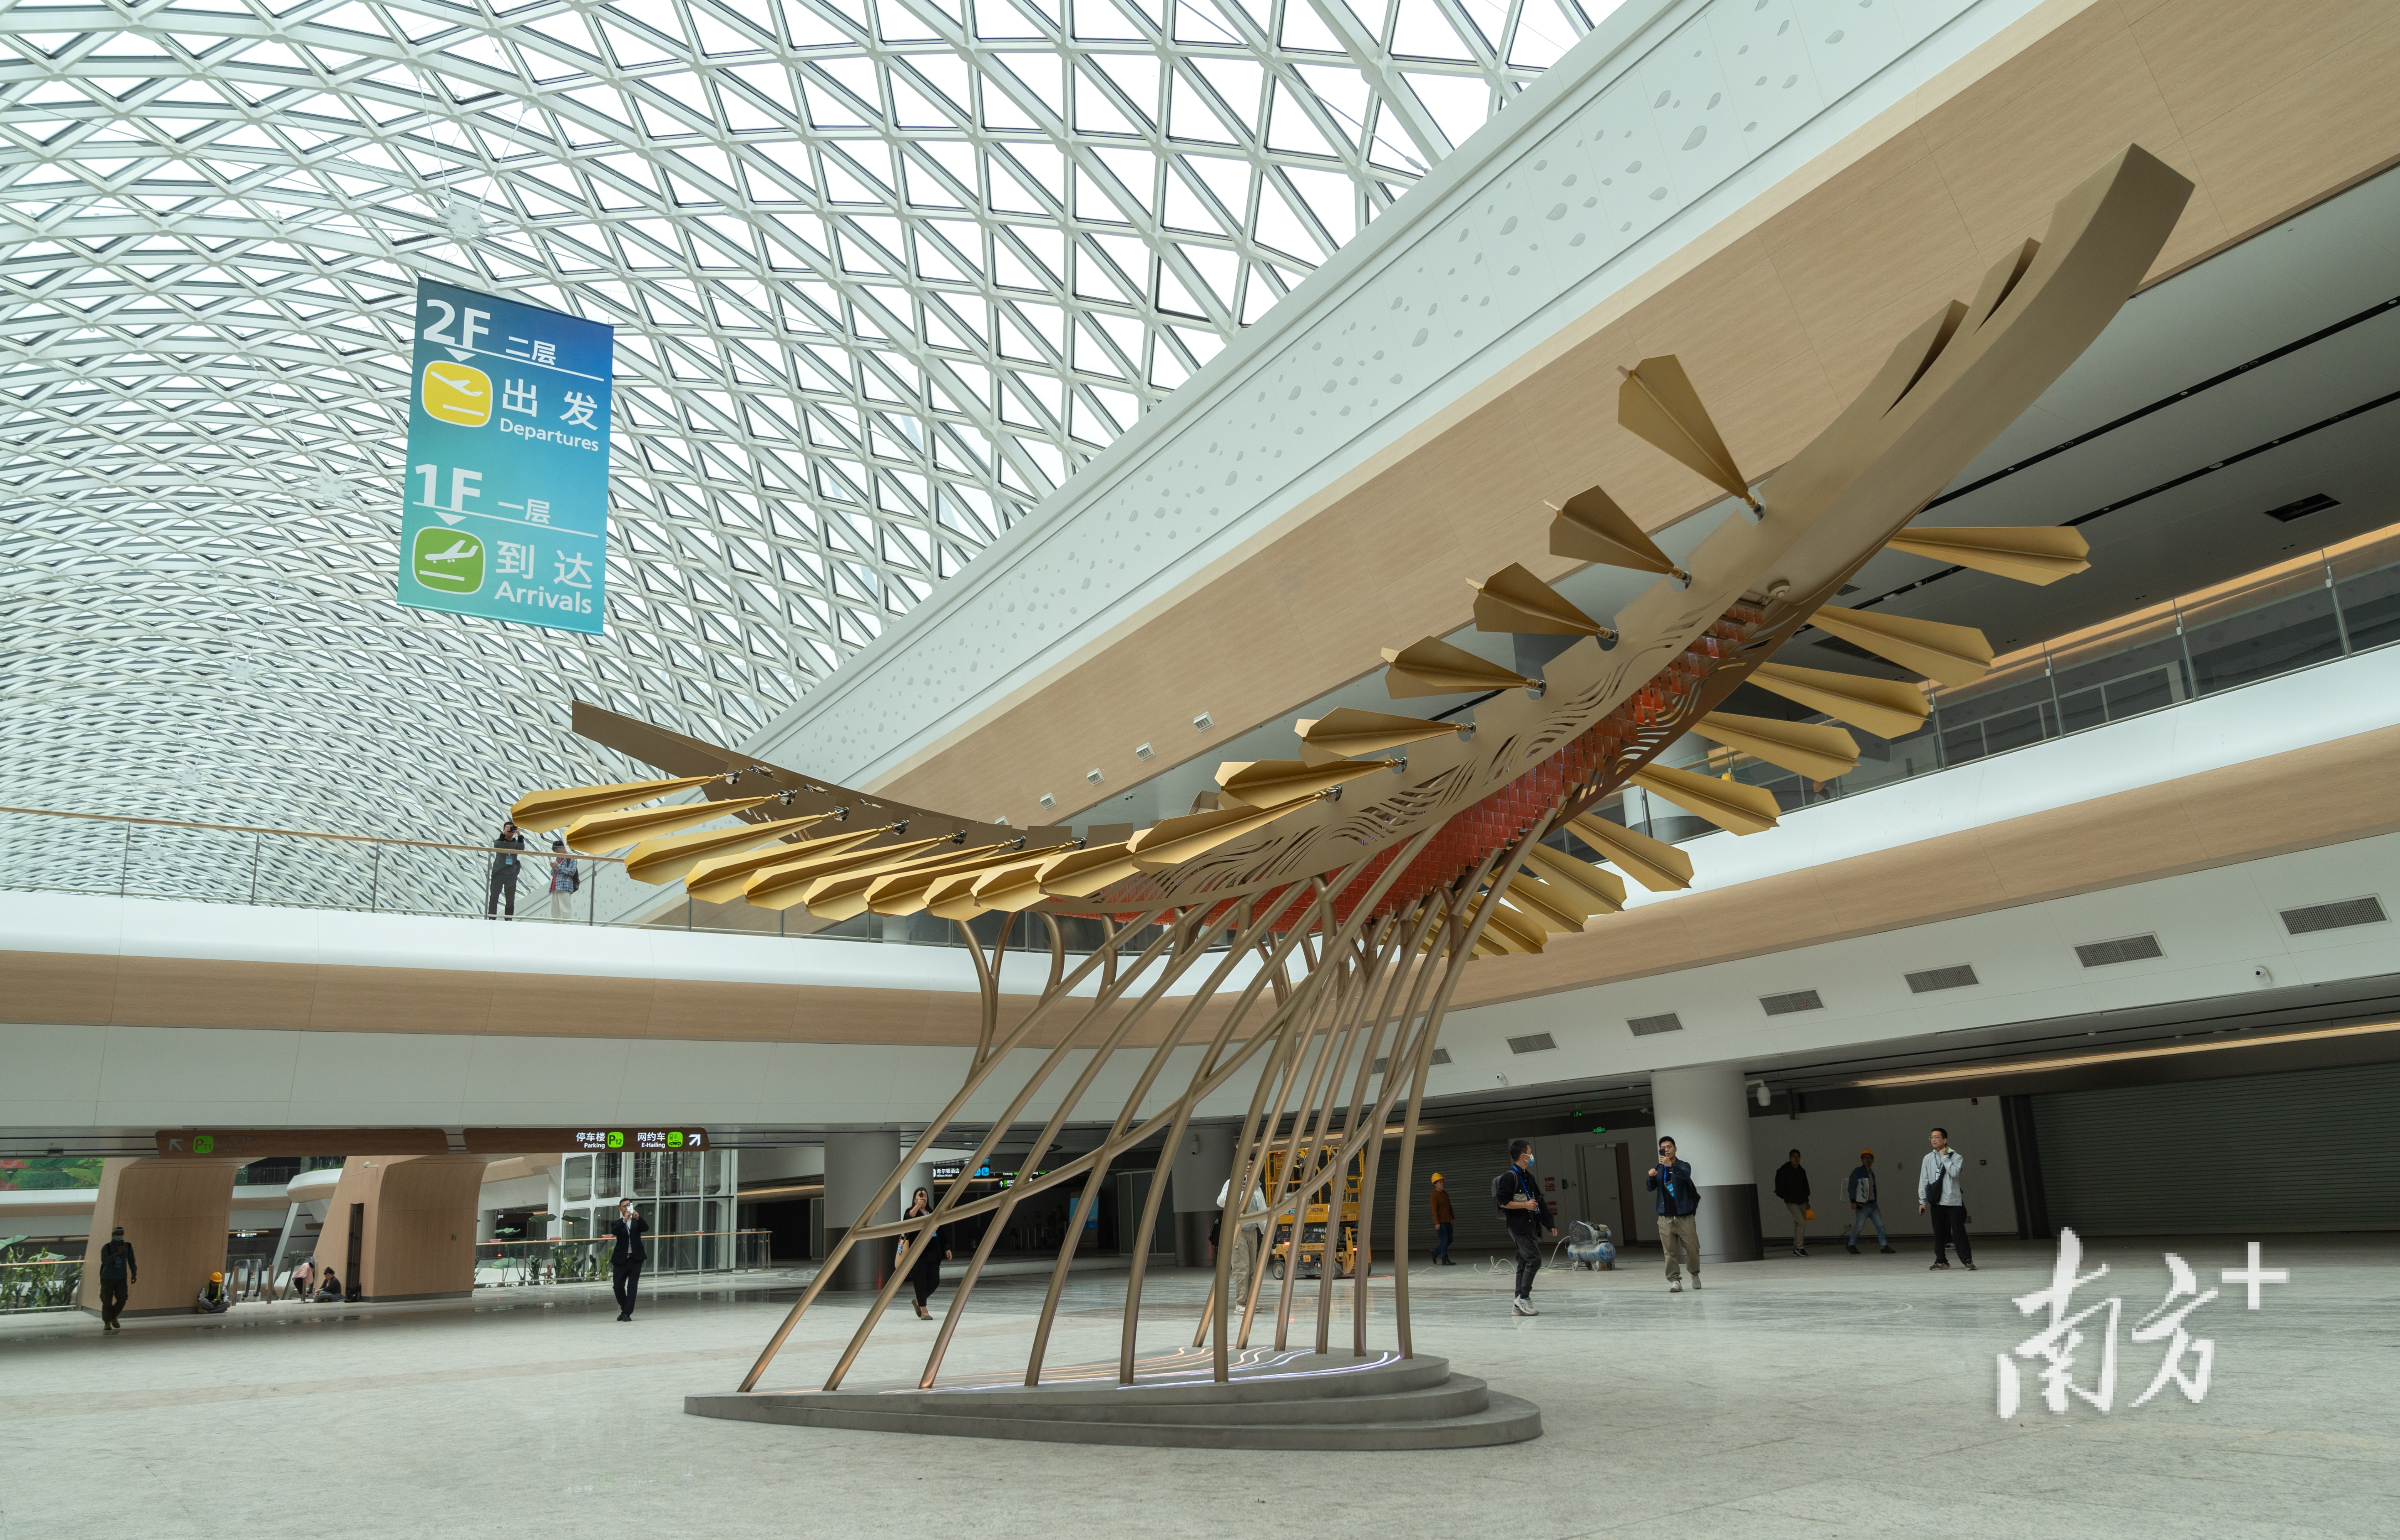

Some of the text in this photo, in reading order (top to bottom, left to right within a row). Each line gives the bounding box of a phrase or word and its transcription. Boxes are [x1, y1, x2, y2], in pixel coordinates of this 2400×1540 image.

[423, 299, 490, 348] 2F
[506, 336, 556, 366] 二层
[502, 378, 598, 431] 出发
[500, 418, 599, 452] Departures
[415, 464, 482, 512] 1F
[498, 499, 551, 524] 一层
[495, 540, 593, 589] 到达
[494, 580, 592, 614] Arrivals
[195, 1138, 212, 1150] P11
[576, 1132, 606, 1142] 停车楼
[608, 1135, 622, 1146] P12
[638, 1132, 666, 1142] 网约车
